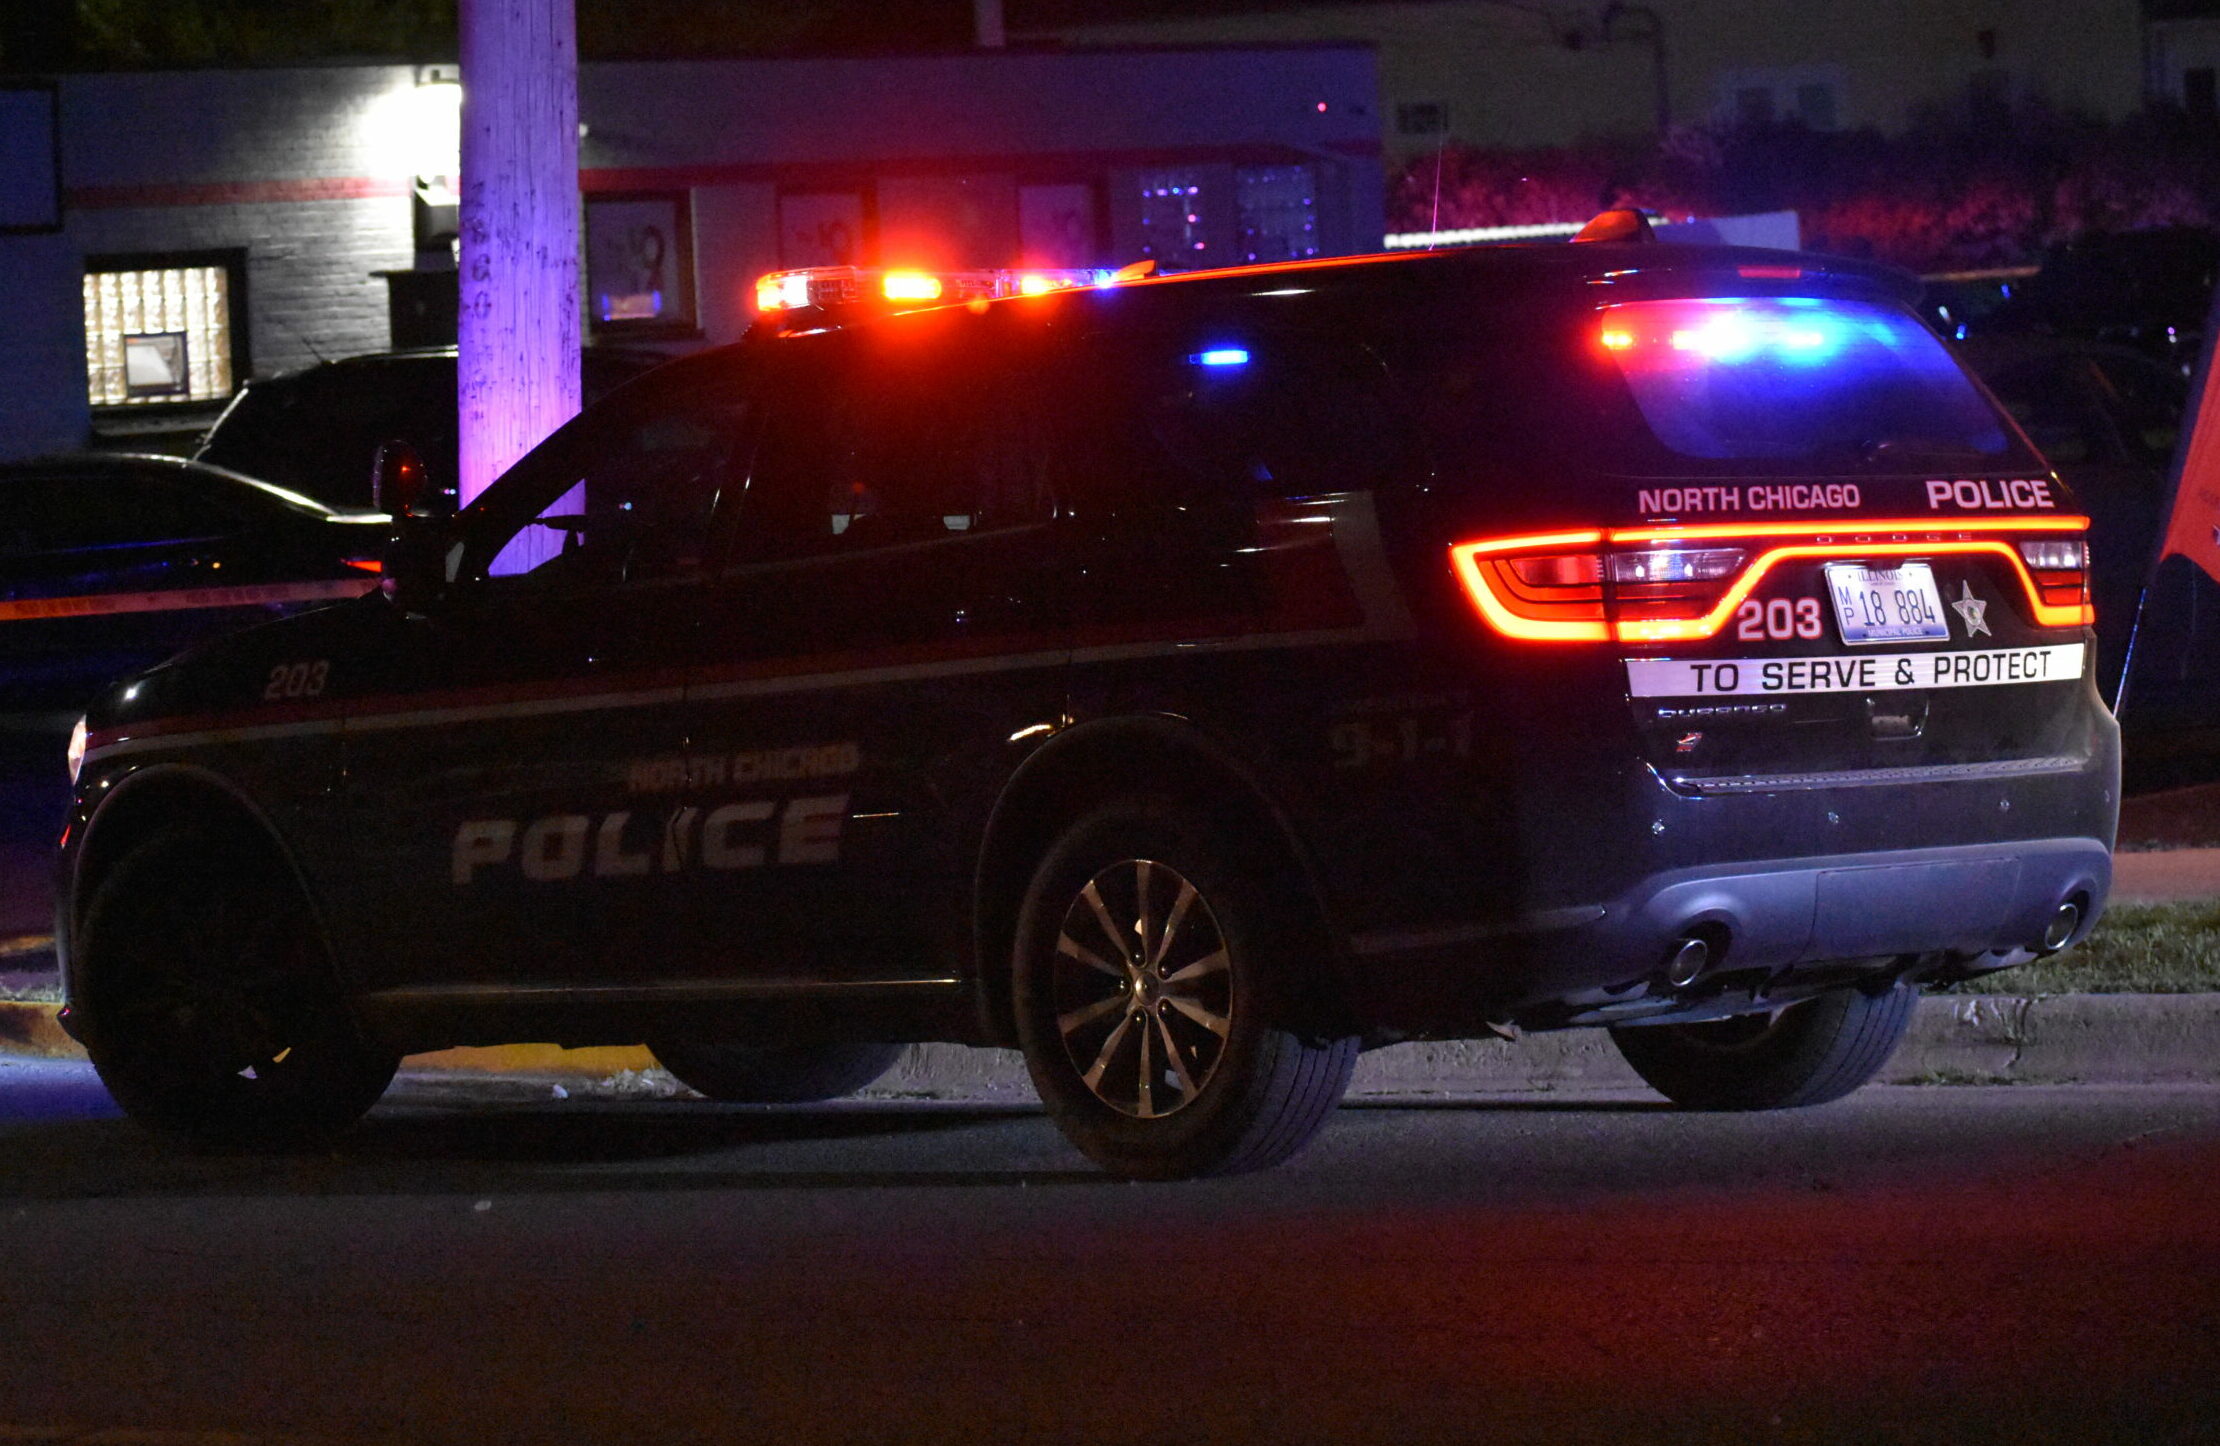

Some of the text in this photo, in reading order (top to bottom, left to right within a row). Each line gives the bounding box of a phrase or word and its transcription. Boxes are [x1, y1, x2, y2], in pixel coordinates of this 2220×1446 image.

[1639, 484, 1861, 513] NORTH CHICAGO
[1927, 480, 2055, 509] POLICE
[1816, 532, 1972, 545] DODGE
[1858, 569, 1904, 583] ILLINOIS
[1737, 598, 1822, 641] 203
[1859, 588, 1936, 626] 18 884
[264, 659, 331, 701] 203
[1690, 651, 2053, 693] TO SERVE & PROTECT
[451, 794, 850, 888] POLICE
